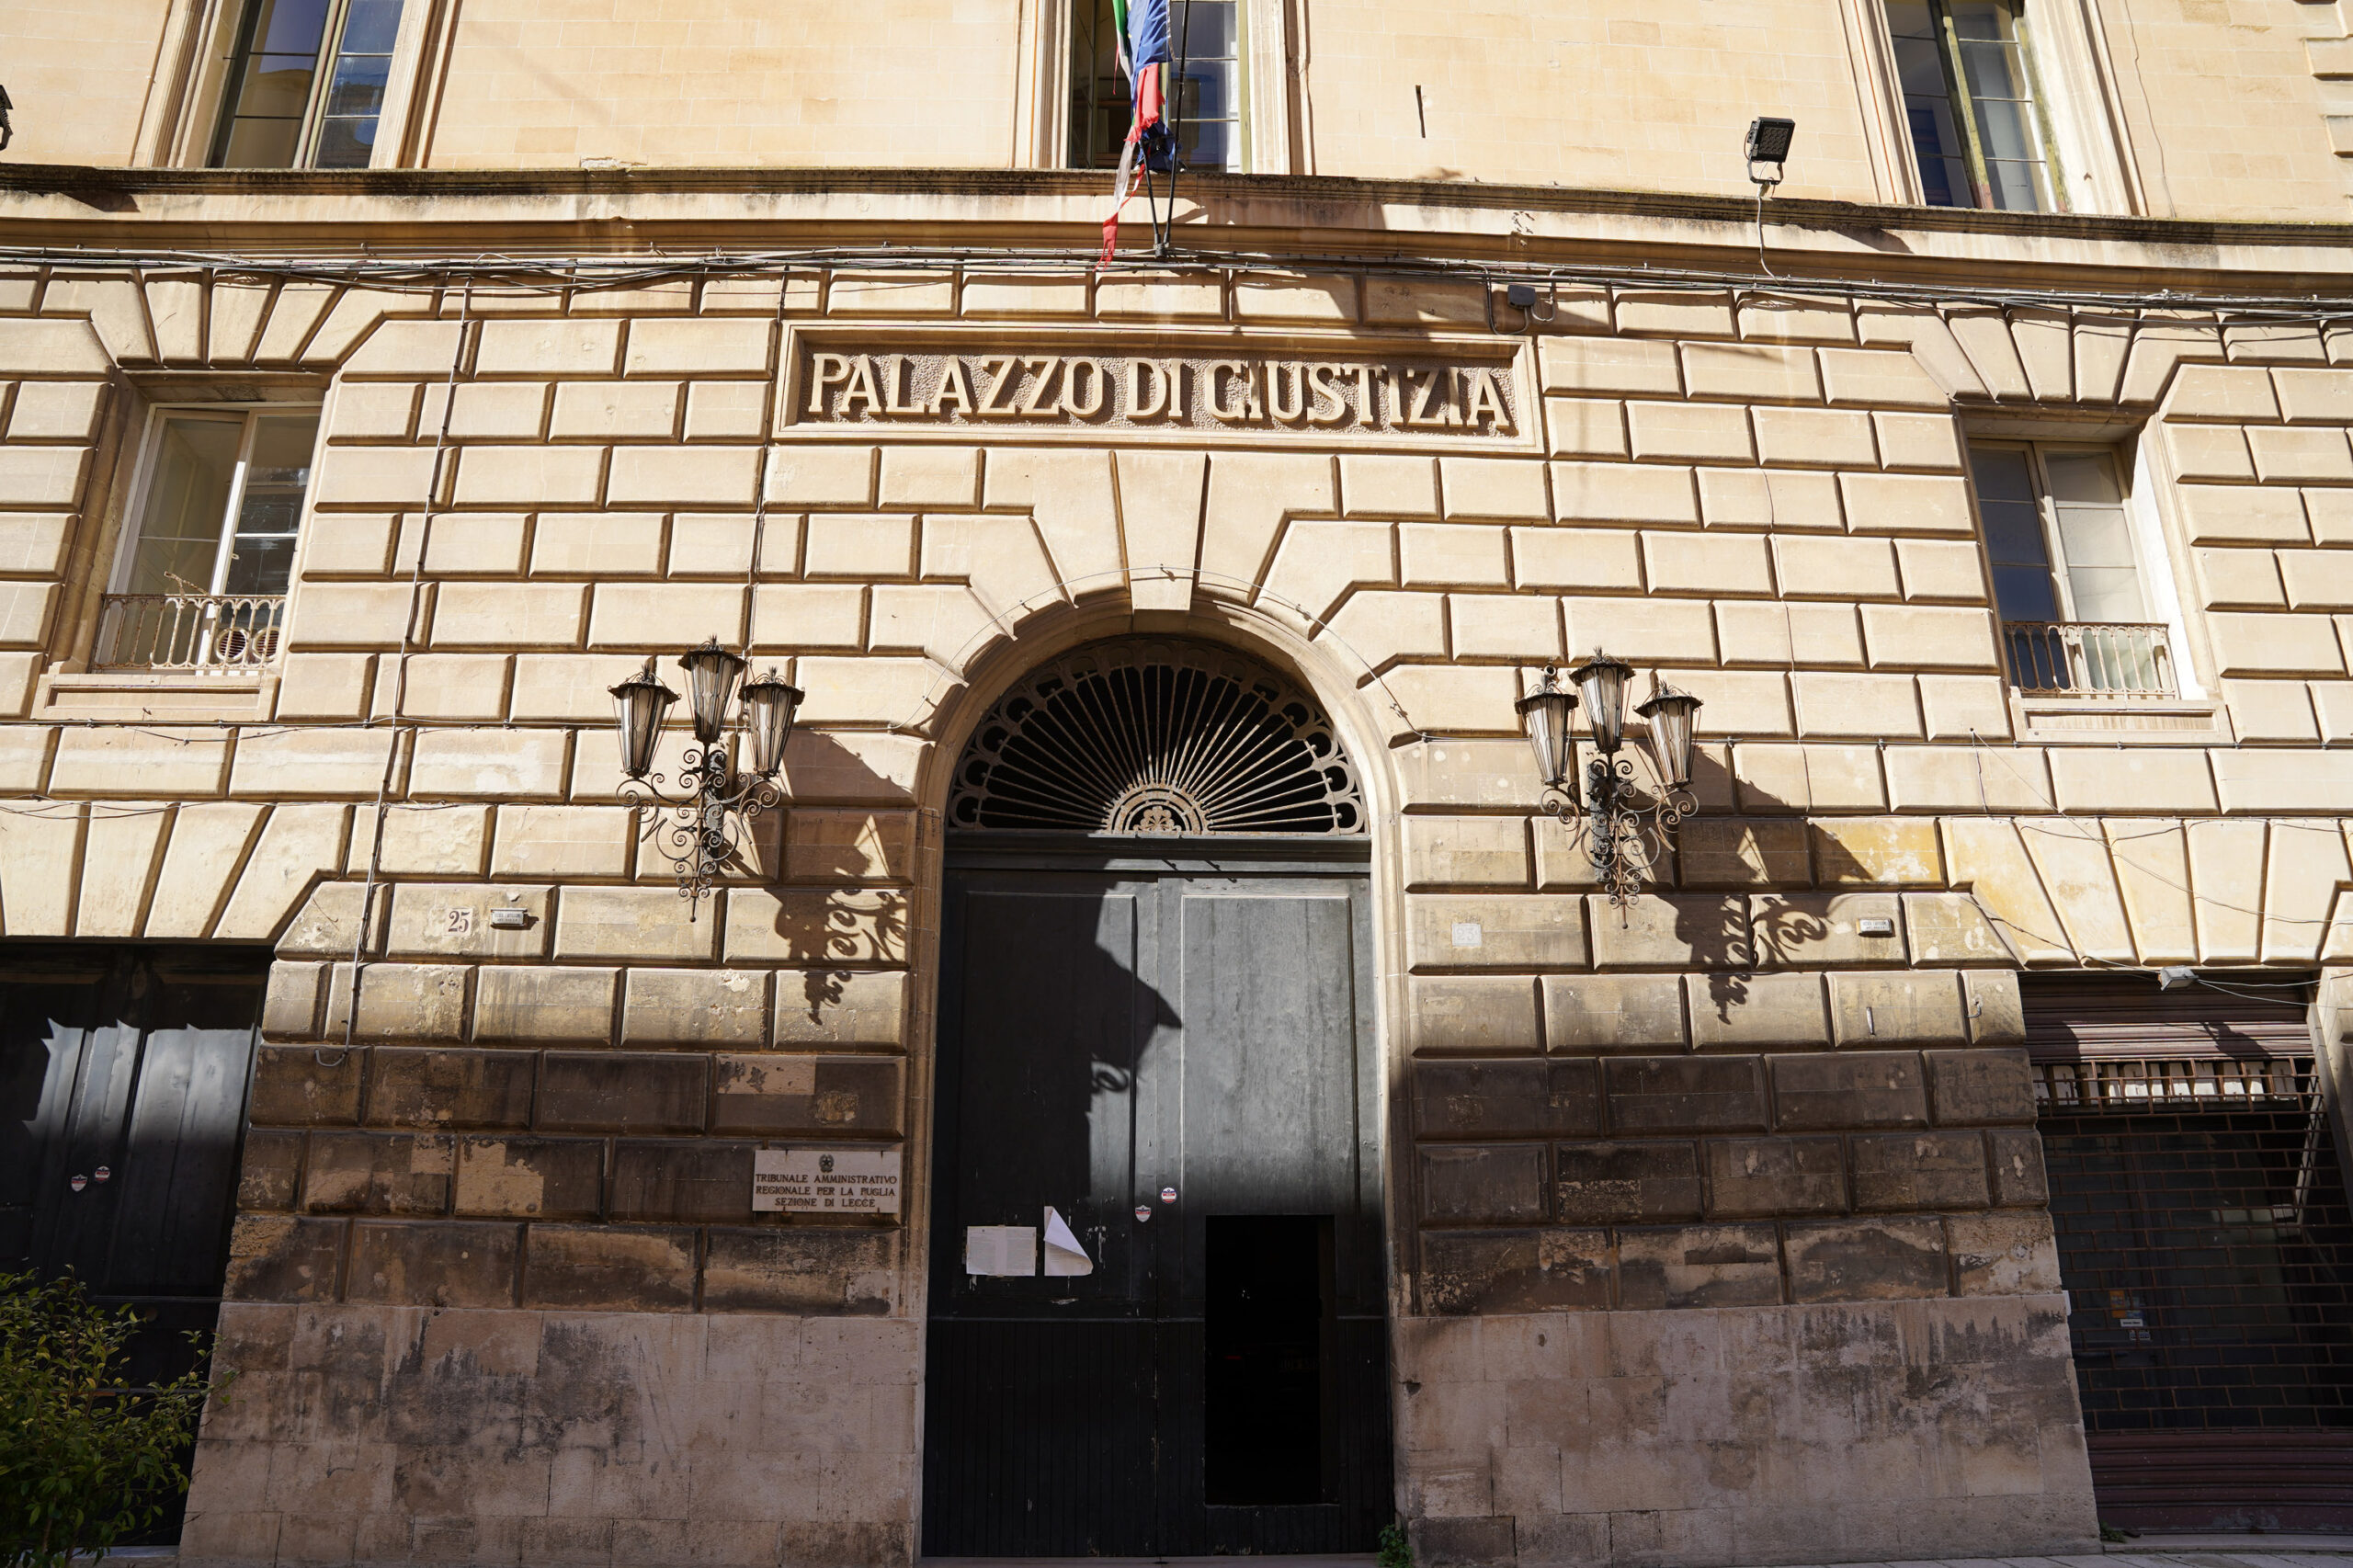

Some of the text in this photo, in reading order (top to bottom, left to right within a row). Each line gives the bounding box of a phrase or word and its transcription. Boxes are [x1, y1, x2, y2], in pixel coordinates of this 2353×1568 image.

[808, 353, 1510, 430] PALAZZO DI GIUSTIZIA
[448, 910, 471, 933] 25
[756, 1174, 898, 1185] TRIBUNALE AMMINISTRATIVO
[756, 1186, 895, 1197] REGIONALE PER LA PUGLIA
[775, 1198, 876, 1208] SEZIONE DI LECCE
